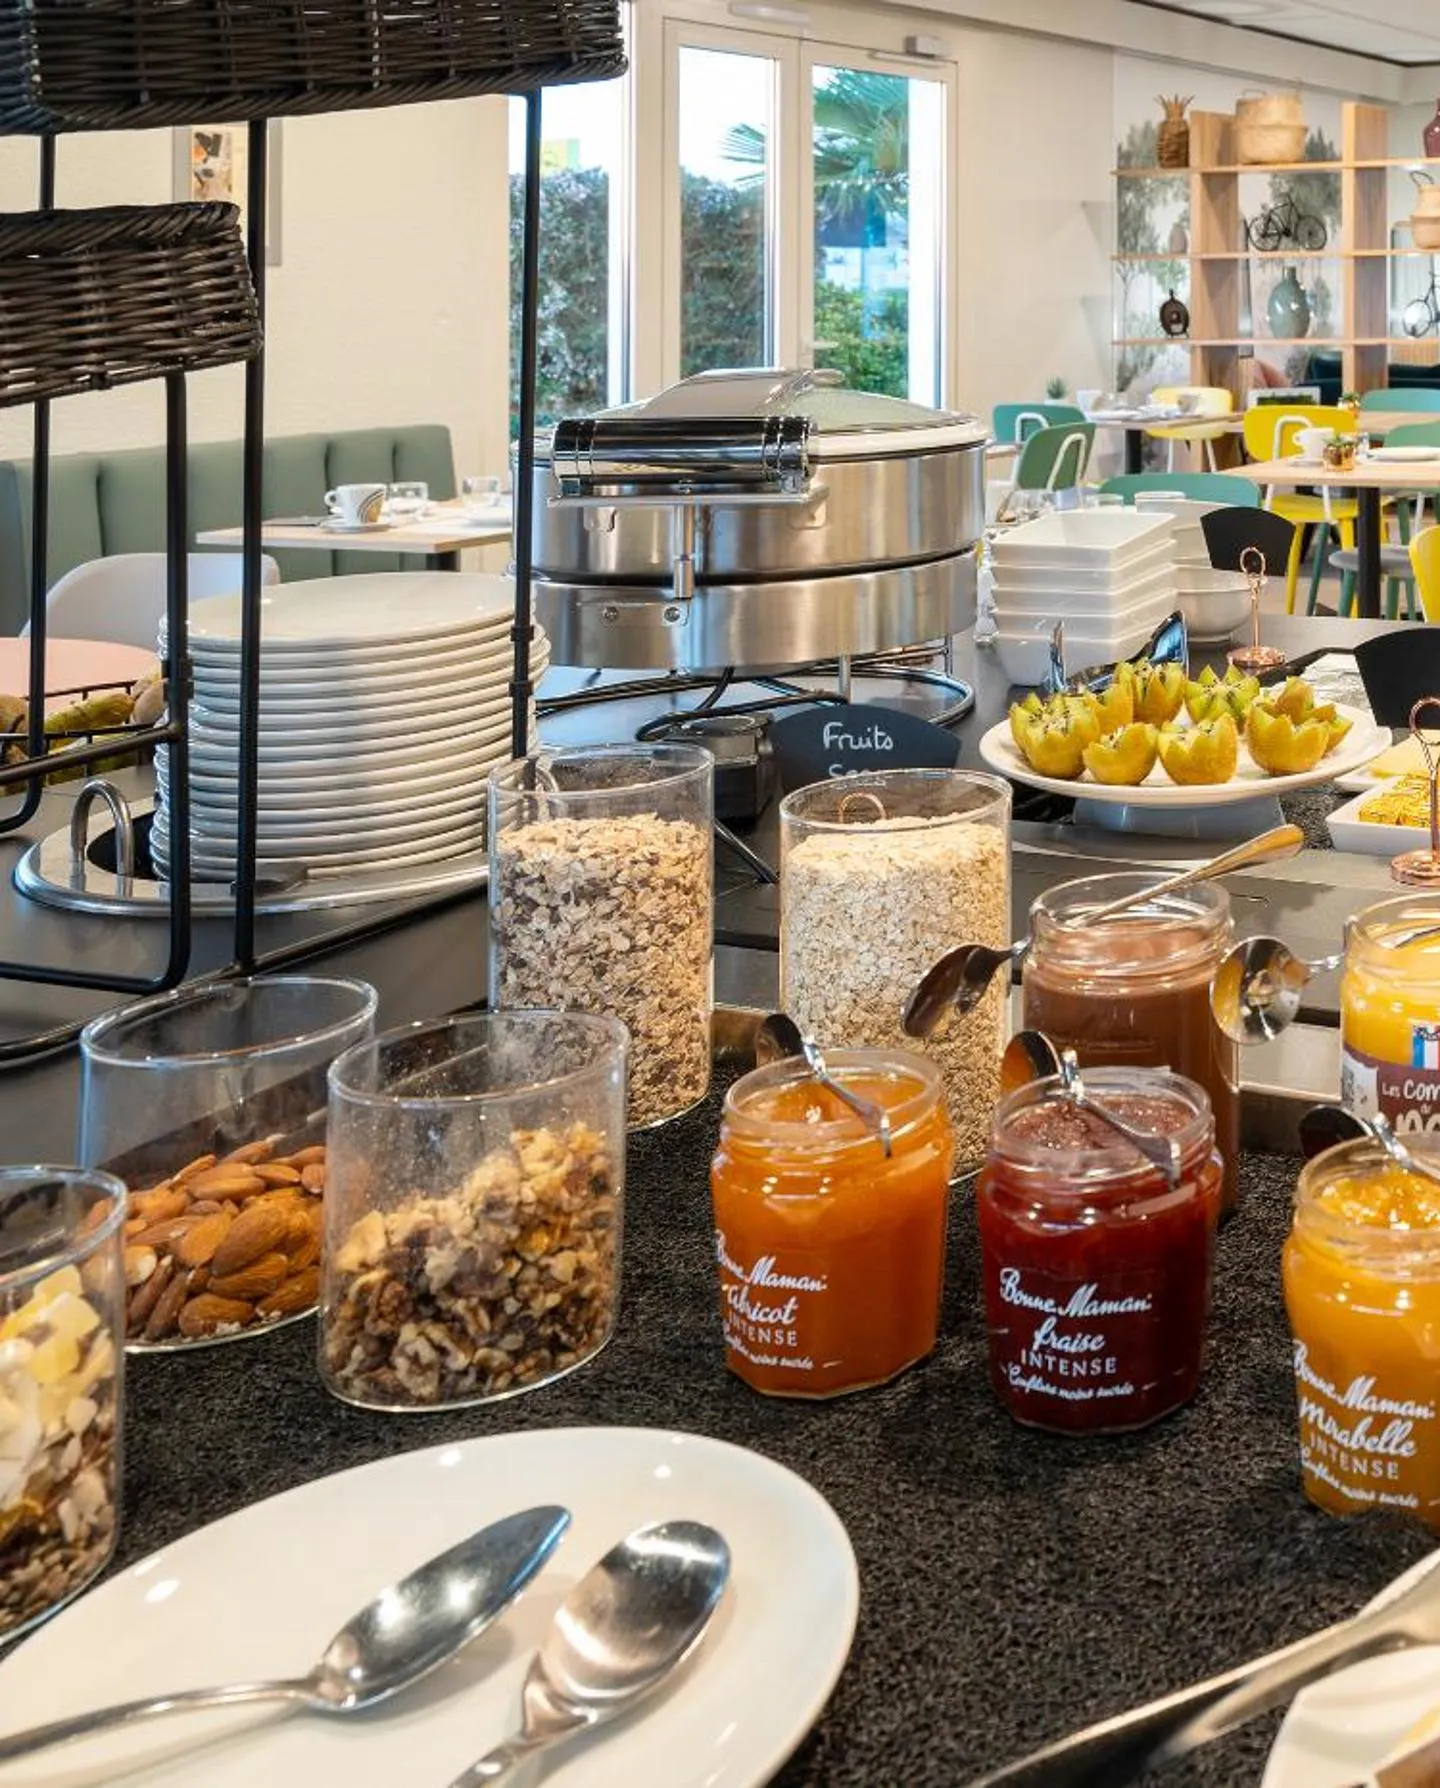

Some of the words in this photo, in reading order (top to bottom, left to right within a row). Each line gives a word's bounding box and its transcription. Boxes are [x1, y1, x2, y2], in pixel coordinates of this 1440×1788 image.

[823, 721, 894, 750] Fruits
[1381, 1082, 1401, 1098] Les
[744, 1255, 828, 1292] Maman
[1000, 1267, 1057, 1313] Bonne
[1057, 1282, 1153, 1318] Maman
[728, 1309, 798, 1347] INTENSE
[1021, 1348, 1118, 1377] INTENSE
[1335, 1375, 1436, 1419] Maman
[1310, 1431, 1399, 1480] INTENSE
